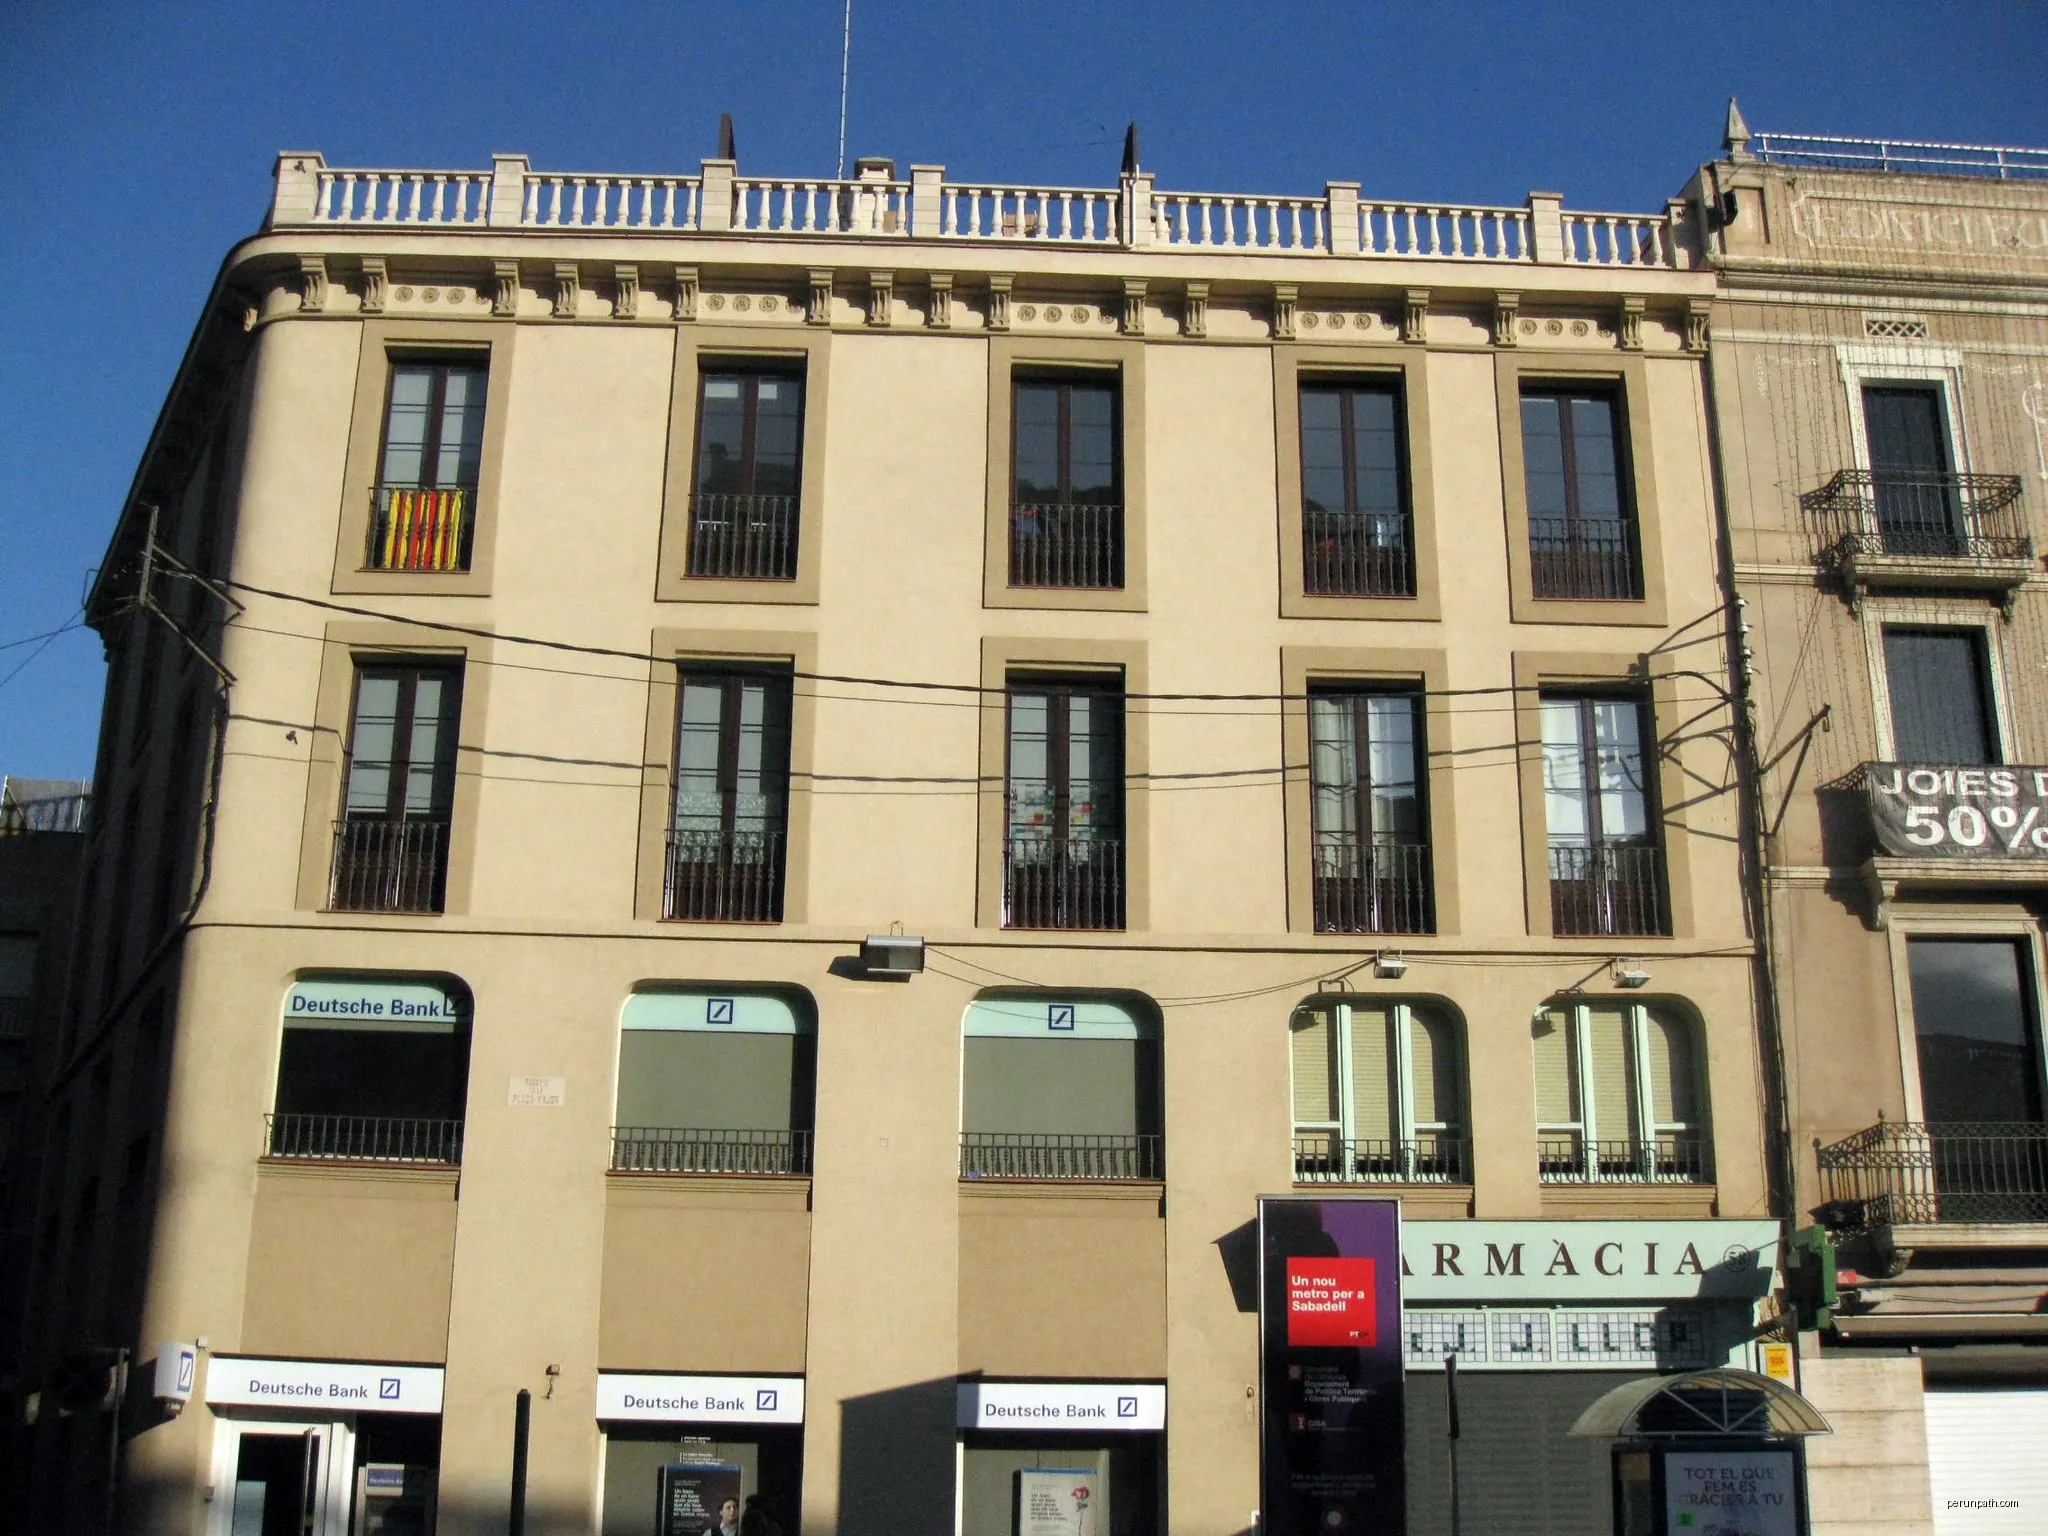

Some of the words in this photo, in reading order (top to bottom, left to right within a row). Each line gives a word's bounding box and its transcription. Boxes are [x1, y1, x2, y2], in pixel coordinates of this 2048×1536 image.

[1881, 769, 2019, 797] JOIES
[1905, 805, 2048, 849] 50%
[292, 995, 384, 1014] Deutsche
[391, 999, 440, 1017] Bank
[1291, 1275, 1309, 1286] Un
[1313, 1277, 1336, 1286] nou
[1292, 1289, 1329, 1298] metro
[1332, 1290, 1354, 1301] per
[1357, 1290, 1365, 1299] a
[1291, 1300, 1346, 1312] Sabadell
[249, 1379, 323, 1396] Deutsche
[329, 1384, 369, 1399] Bank
[624, 1394, 699, 1410] Deutsche
[705, 1397, 745, 1411] Bank
[985, 1403, 1060, 1418] Deutsche
[1066, 1404, 1106, 1418] Bank
[1684, 1467, 1716, 1480] TOT
[1721, 1467, 1738, 1480] EL
[1742, 1467, 1775, 1480] QUE
